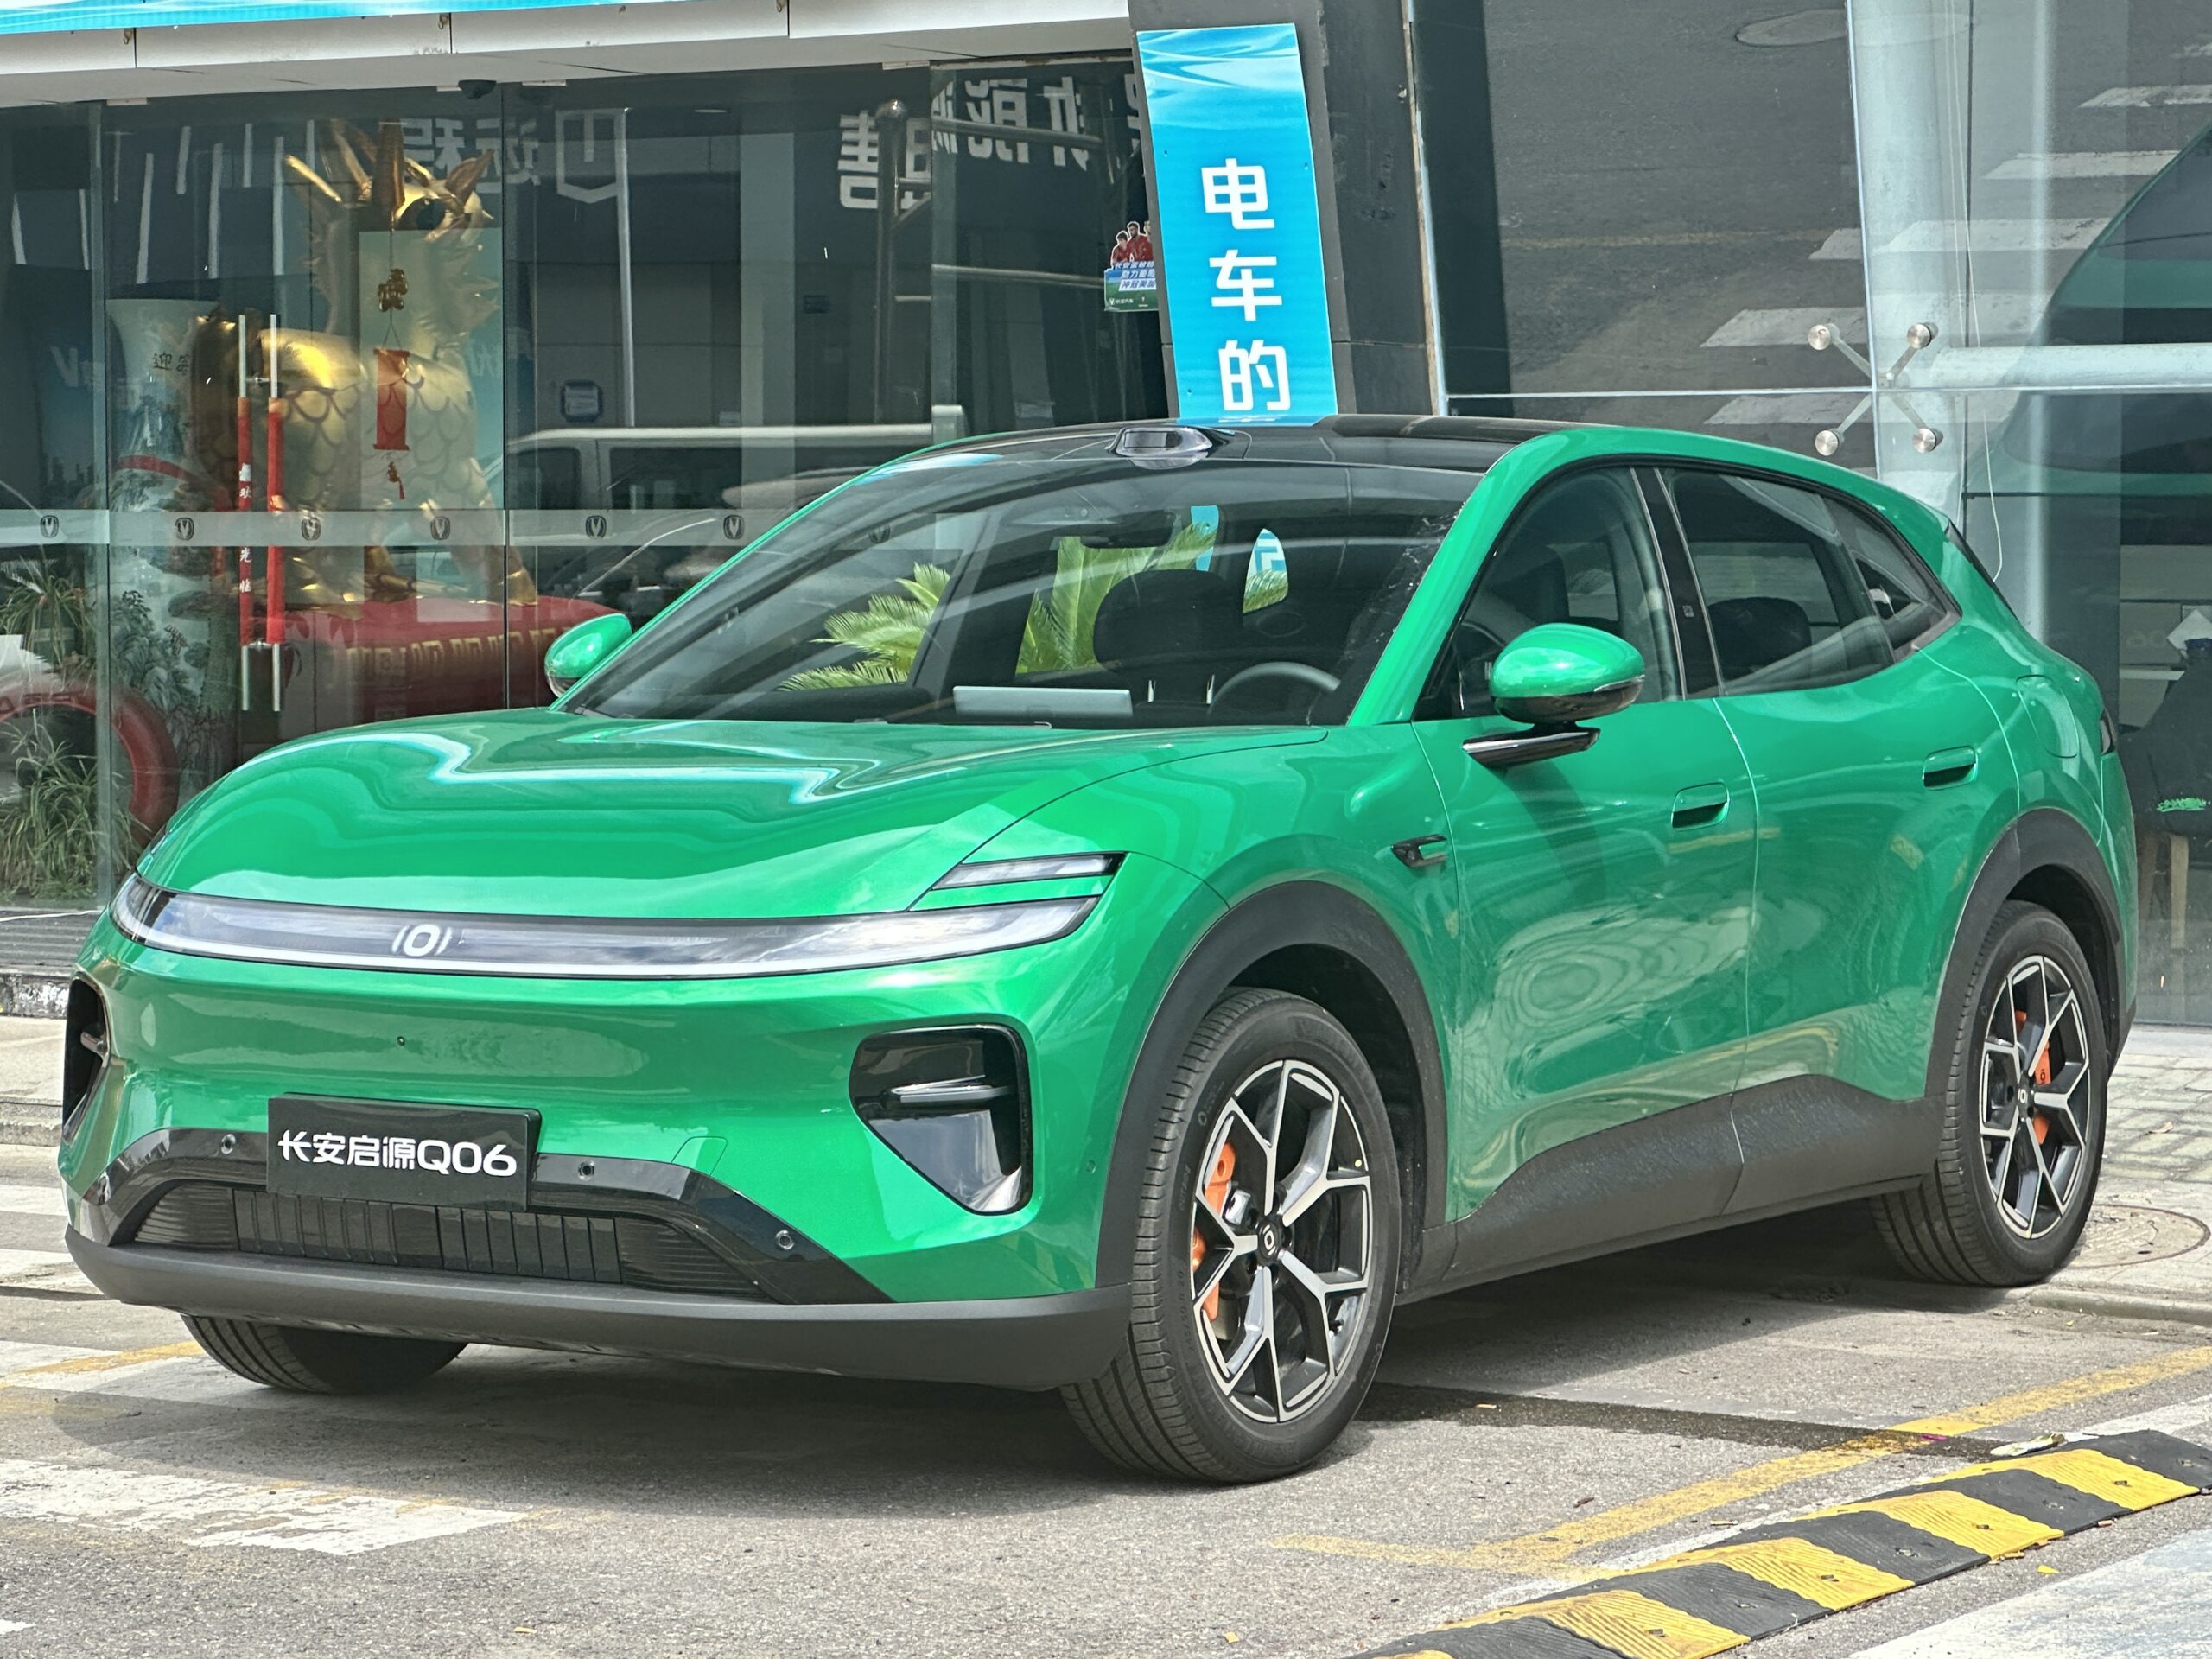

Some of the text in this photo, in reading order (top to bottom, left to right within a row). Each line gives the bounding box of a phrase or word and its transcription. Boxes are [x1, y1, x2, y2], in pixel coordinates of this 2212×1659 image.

[1200, 157, 1291, 411] 电车的
[277, 1129, 517, 1177] 长安启源Q06
